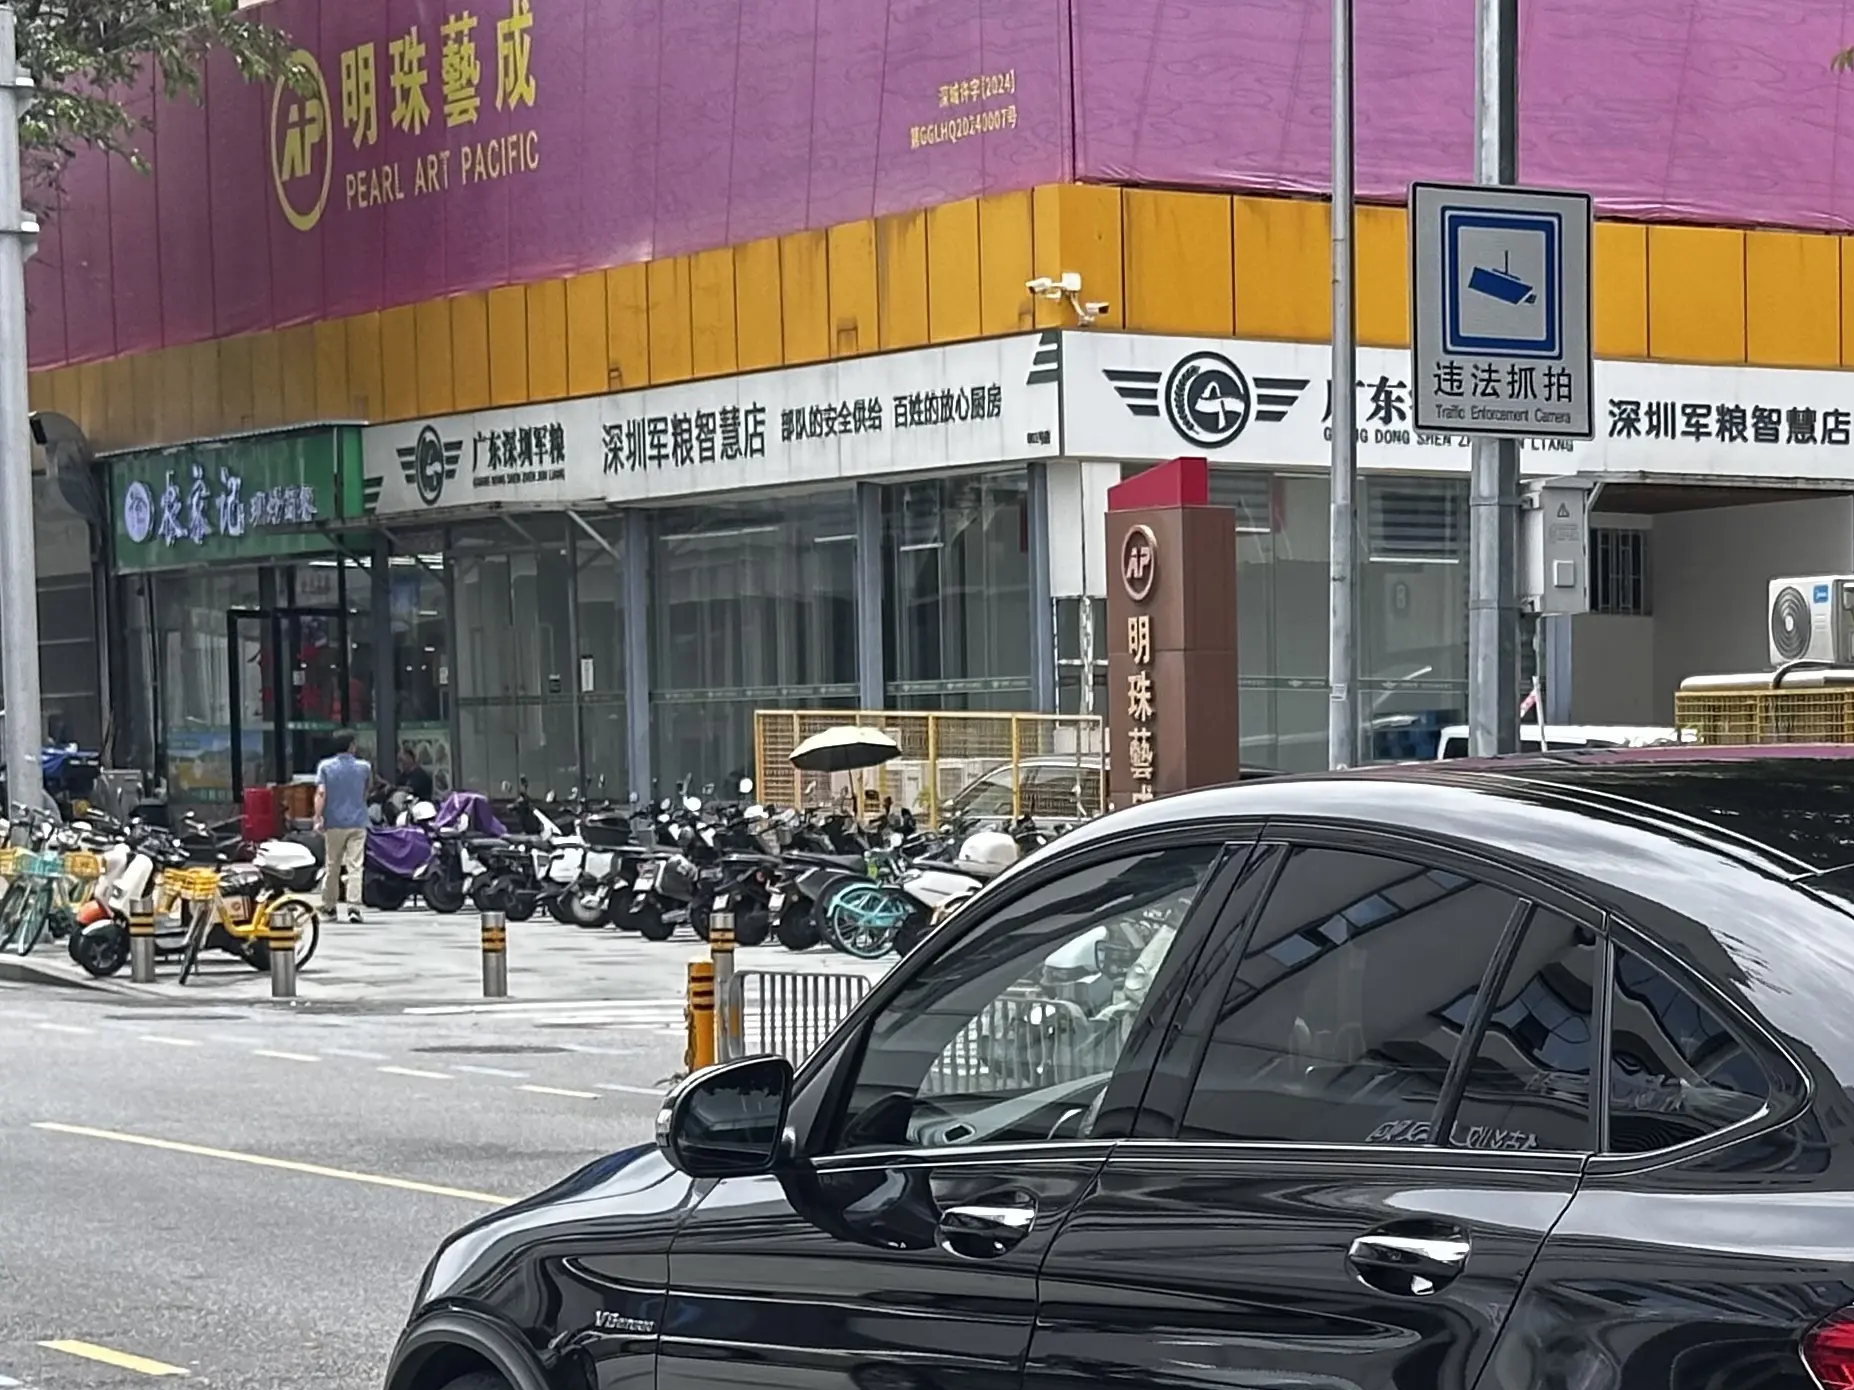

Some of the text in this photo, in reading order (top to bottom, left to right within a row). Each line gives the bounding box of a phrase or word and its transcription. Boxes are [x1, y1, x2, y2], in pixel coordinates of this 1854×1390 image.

[340, 0, 536, 149] 明珠藝成
[345, 130, 540, 211] PEARL ART PACIFIC
[1433, 360, 1574, 403] 违法抓拍
[602, 381, 1002, 475] 深圳军粮智慧店 部队的安全供给 百姓的放心厨房
[1374, 428, 1410, 445] DONG
[1436, 404, 1572, 424] Traffic Enforcement Camera
[1607, 398, 1852, 446] 深圳军粮智慧店
[472, 421, 566, 473] 广东深圳军粮
[1127, 615, 1155, 803] 明珠藝
